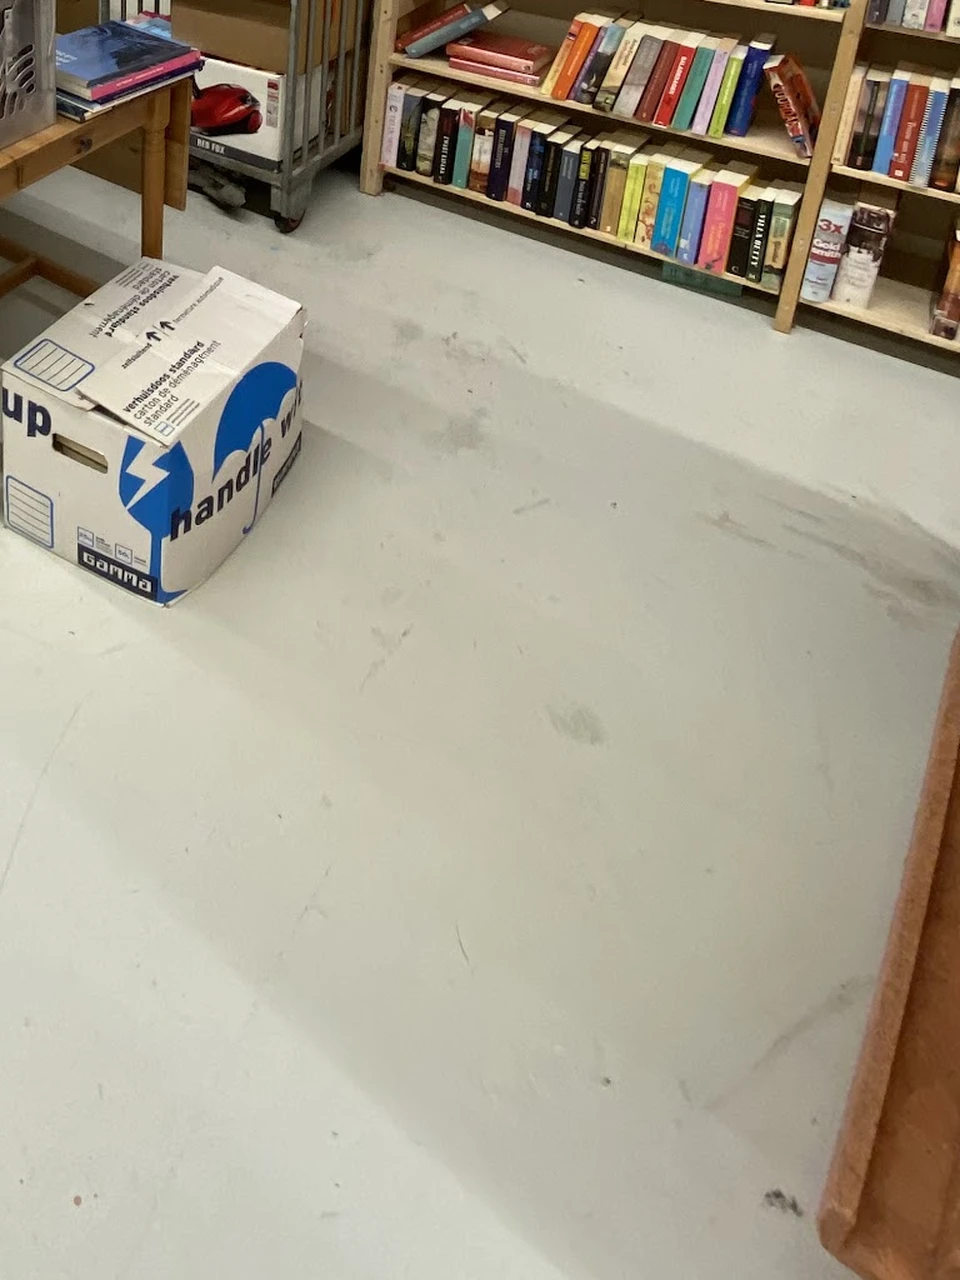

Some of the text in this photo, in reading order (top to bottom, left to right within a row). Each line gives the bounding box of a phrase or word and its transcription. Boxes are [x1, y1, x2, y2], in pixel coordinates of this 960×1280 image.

[197, 139, 225, 154] RED FOX
[749, 213, 767, 268] VILLA BETTY
[813, 239, 840, 250] Gold
[818, 219, 844, 235] 3x
[812, 248, 841, 257] smith
[123, 341, 205, 413] verhuisdoos standaard
[133, 340, 221, 420] carton de déménagement
[2, 387, 52, 438] up
[143, 395, 179, 427] standard
[170, 437, 272, 542] handle
[82, 552, 152, 593] GAMMA
